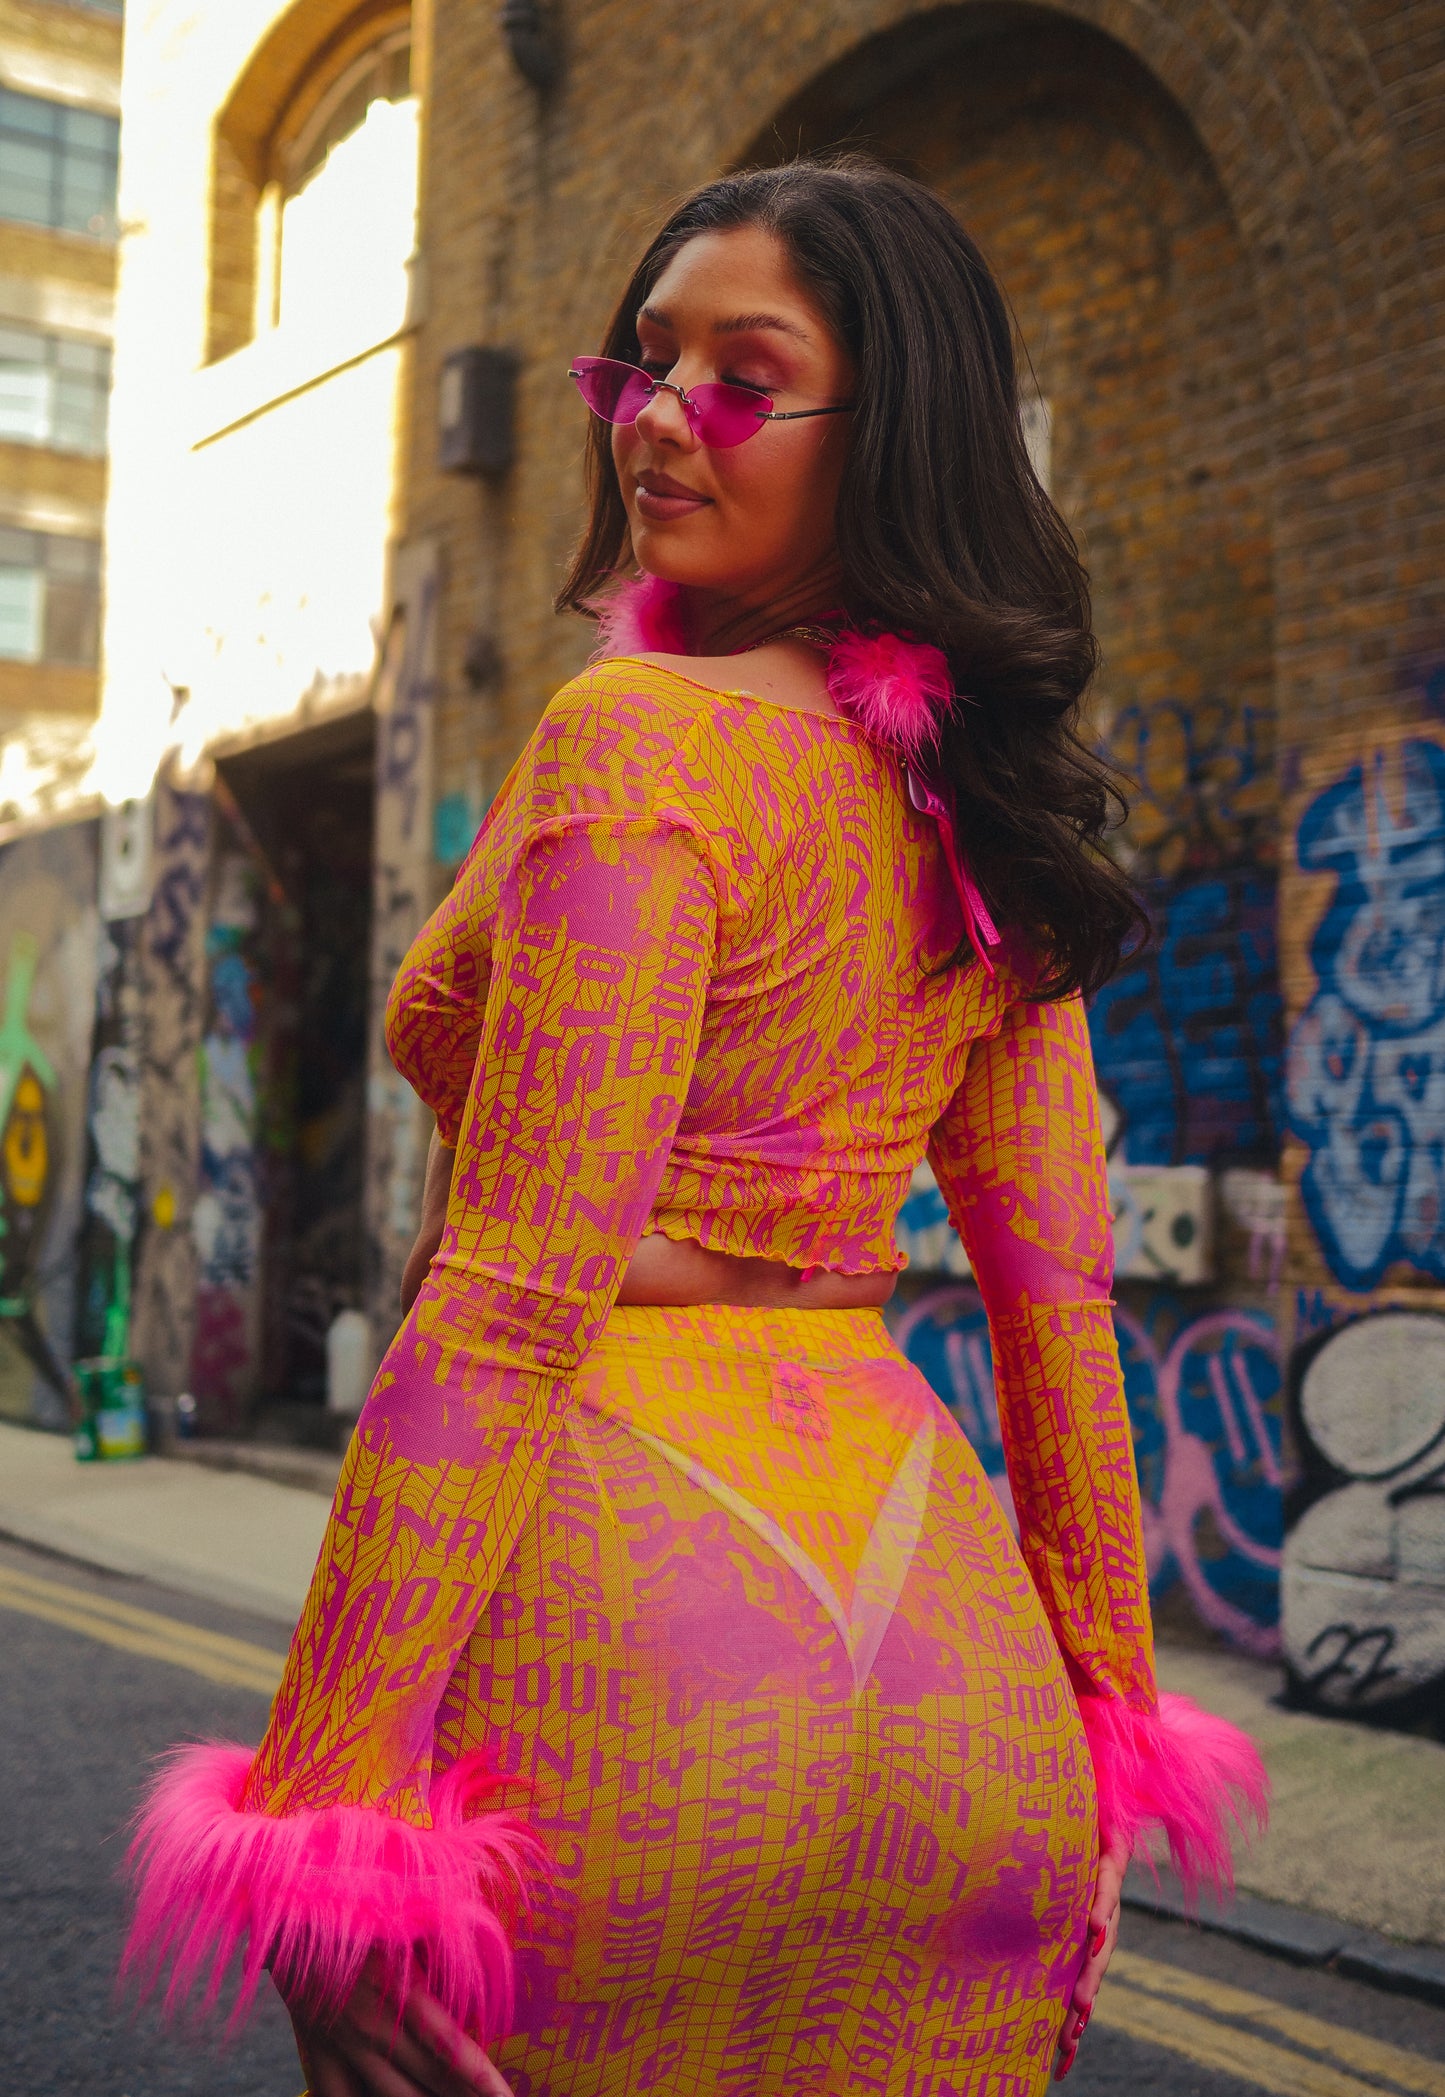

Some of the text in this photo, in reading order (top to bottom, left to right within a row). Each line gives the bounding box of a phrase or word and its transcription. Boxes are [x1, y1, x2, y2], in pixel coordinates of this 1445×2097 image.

[647, 874, 718, 1021] UNITY
[1081, 1349, 1133, 1482] UNITY
[334, 1484, 488, 1561] UNIT
[1092, 1484, 1145, 1634] PEACE
[489, 1592, 660, 1650] PEAC
[486, 1726, 698, 1791] UNITY
